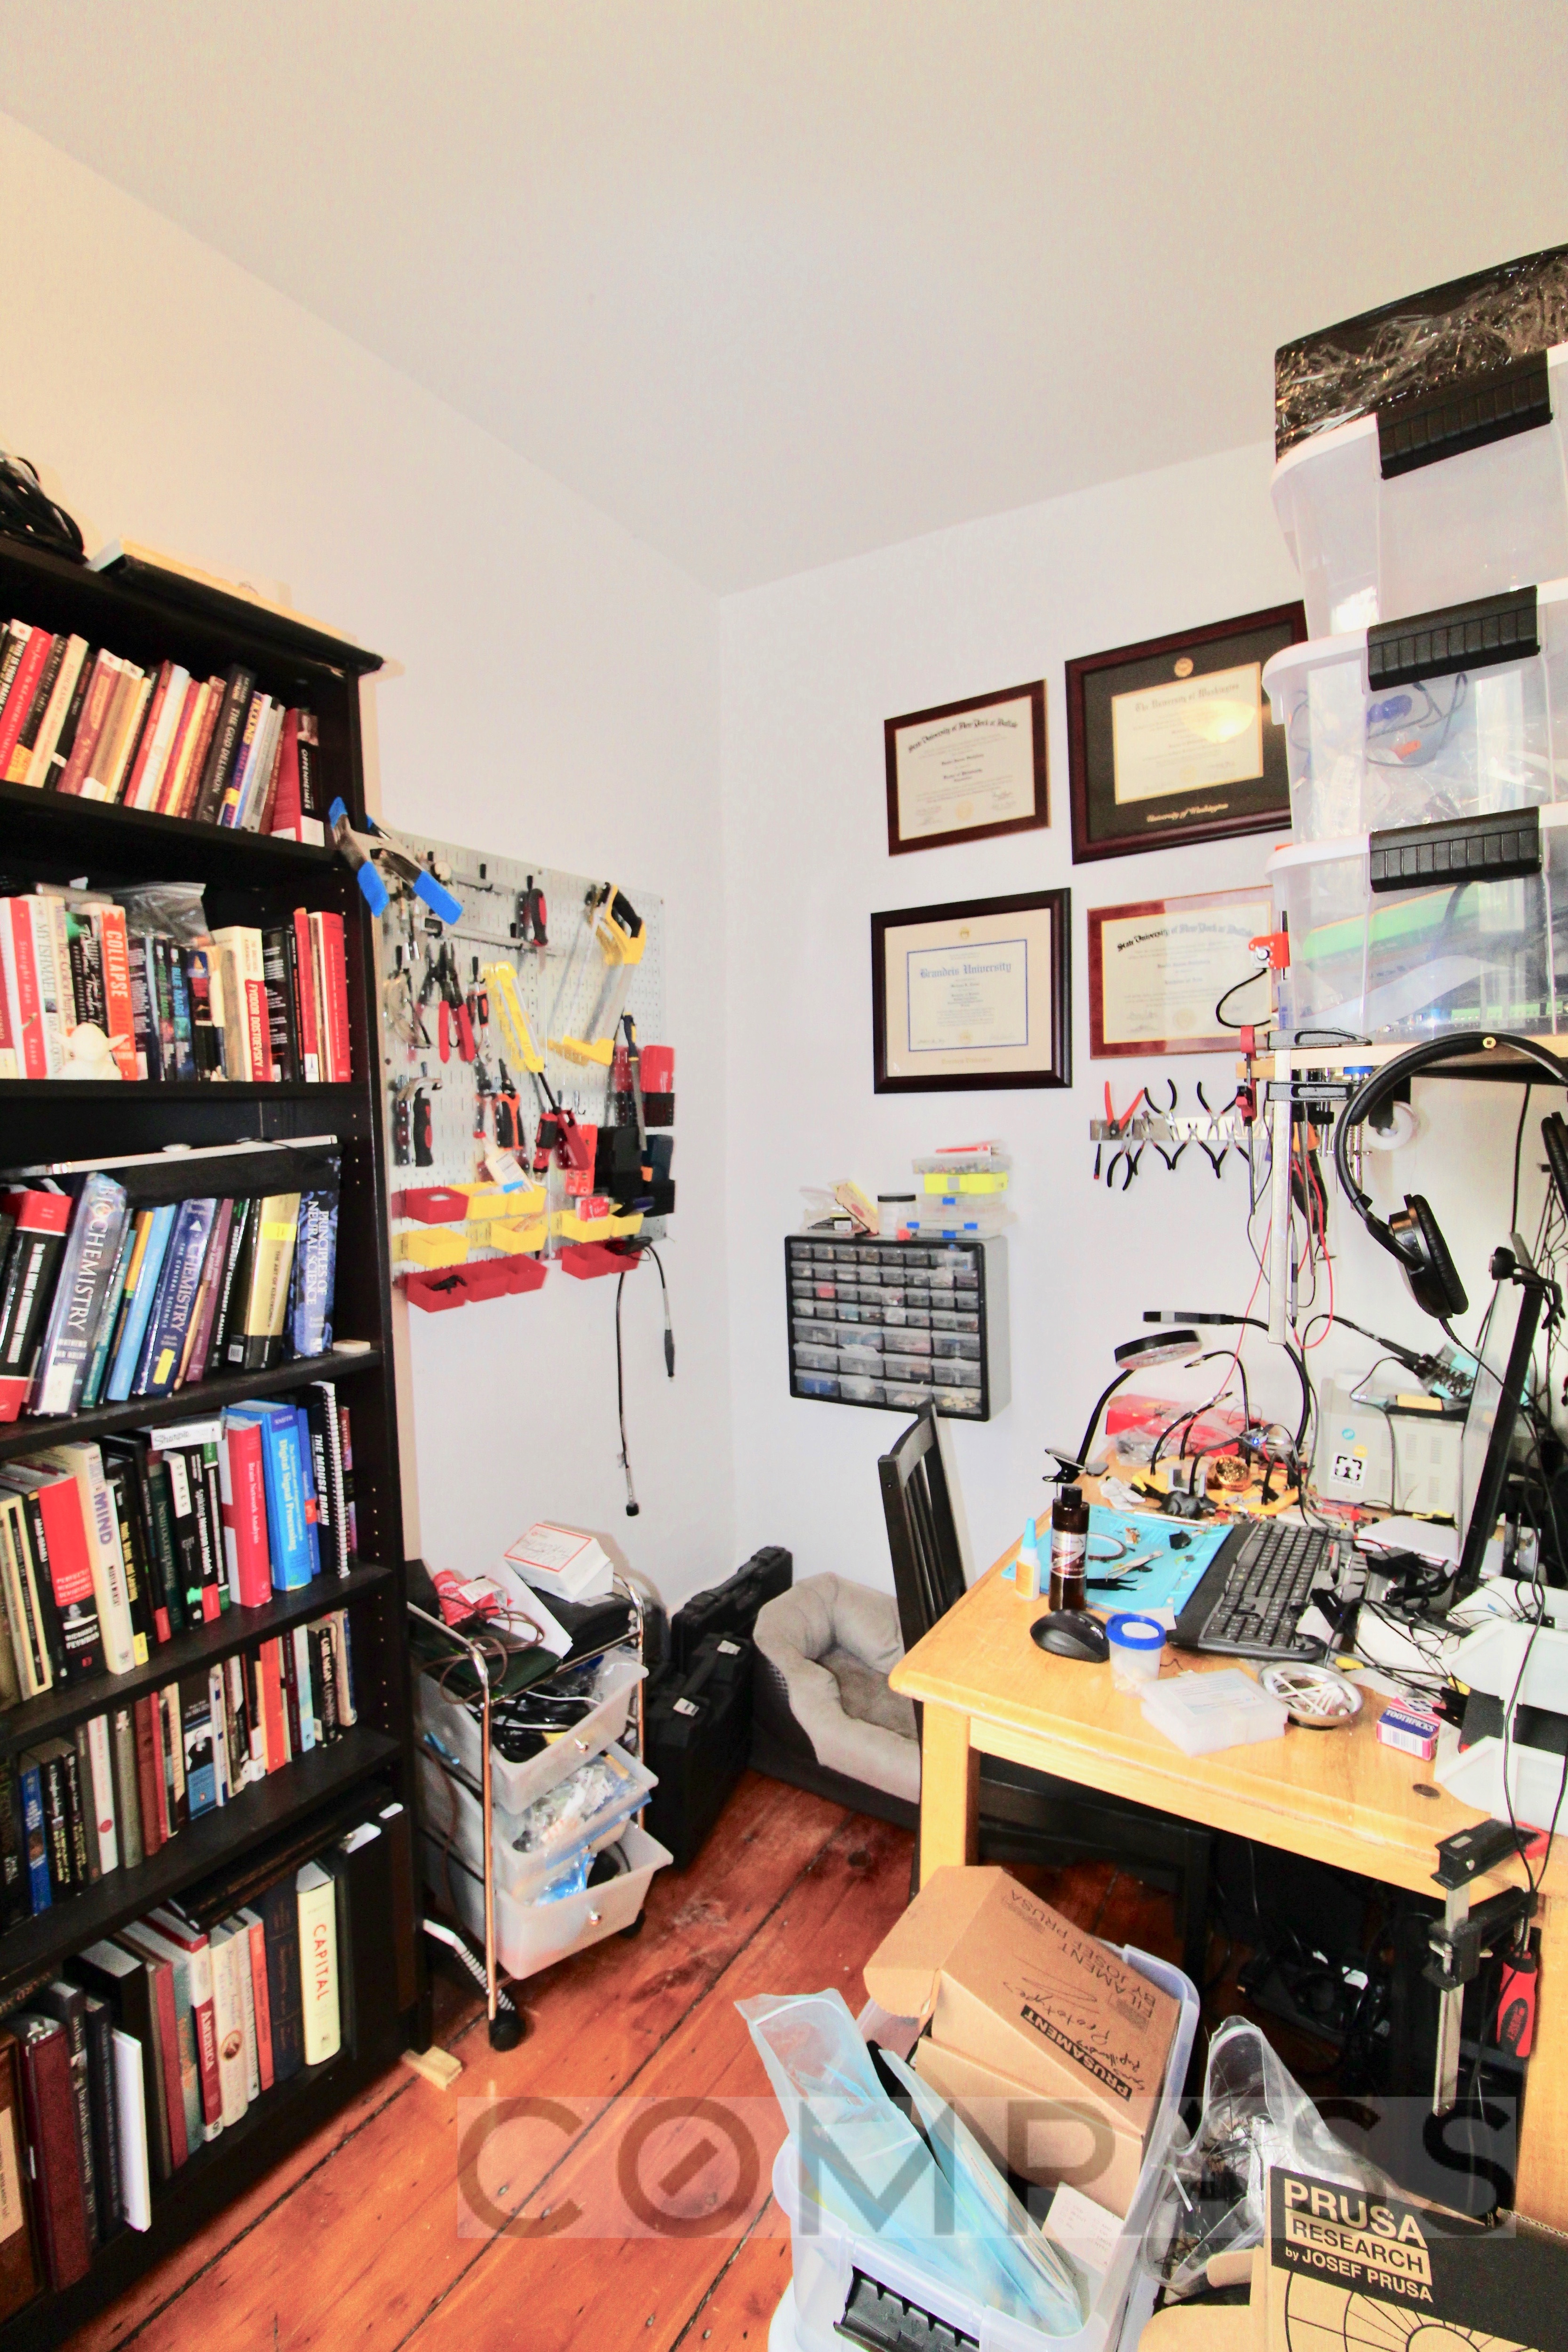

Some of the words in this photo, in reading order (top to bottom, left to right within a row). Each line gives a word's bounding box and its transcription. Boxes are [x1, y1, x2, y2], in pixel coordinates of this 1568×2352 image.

[223, 726, 236, 747] GOD
[228, 707, 240, 726] THE
[210, 747, 230, 794] DELUSION
[301, 749, 311, 809] OPPENHEIMER
[36, 922, 49, 943] MY
[17, 940, 31, 980] Straight
[38, 943, 56, 997] ISHMAEL
[105, 930, 128, 999] COLLAPSE
[171, 967, 181, 987] BLUE
[920, 968, 959, 978] Brandeis
[963, 962, 1011, 976] University
[173, 989, 184, 1017] MARS
[248, 983, 260, 1015] FYODOR
[28, 1038, 39, 1065] Russo
[249, 1016, 265, 1067] DOSTOEVSKY
[304, 1200, 321, 1253] NEURAL
[313, 1209, 332, 1279] PRINCIPLES
[66, 1180, 118, 1332] BIOCHEMISTRY
[168, 1242, 201, 1333] CHEMISTRY
[220, 1271, 233, 1312] COMPONENT
[302, 1255, 320, 1305] SCIENCE
[215, 1313, 226, 1345] ANALYSIS
[154, 1430, 189, 1447] Sharpie
[278, 1439, 290, 1471] Digital
[315, 1434, 324, 1453] THE
[176, 1463, 188, 1509] SPKES
[247, 1462, 256, 1482] Brain
[281, 1472, 293, 1501] Signal
[316, 1455, 327, 1492] MOUSE
[93, 1492, 114, 1545] MIND
[195, 1489, 206, 1518] Spiking
[318, 1494, 330, 1526] BRAIN
[199, 1518, 209, 1546] Neuron
[284, 1502, 298, 1551] Processing
[201, 1547, 212, 1575] Models
[1386, 1709, 1435, 1732] TOOTHPICKS
[1011, 1889, 1068, 1939] PRUSA
[310, 1923, 331, 2001] CAPITAL
[1062, 1943, 1154, 2019] FILAMENT
[200, 2011, 215, 2071] AMERICA
[1026, 2009, 1130, 2097] PRUSAMENT
[1284, 2178, 1428, 2249] PRUSA
[1292, 2218, 1424, 2274] RESEARCH
[1285, 2247, 1299, 2261] by
[1302, 2249, 1362, 2279] JOSEF
[1367, 2268, 1433, 2303] PRUSA
